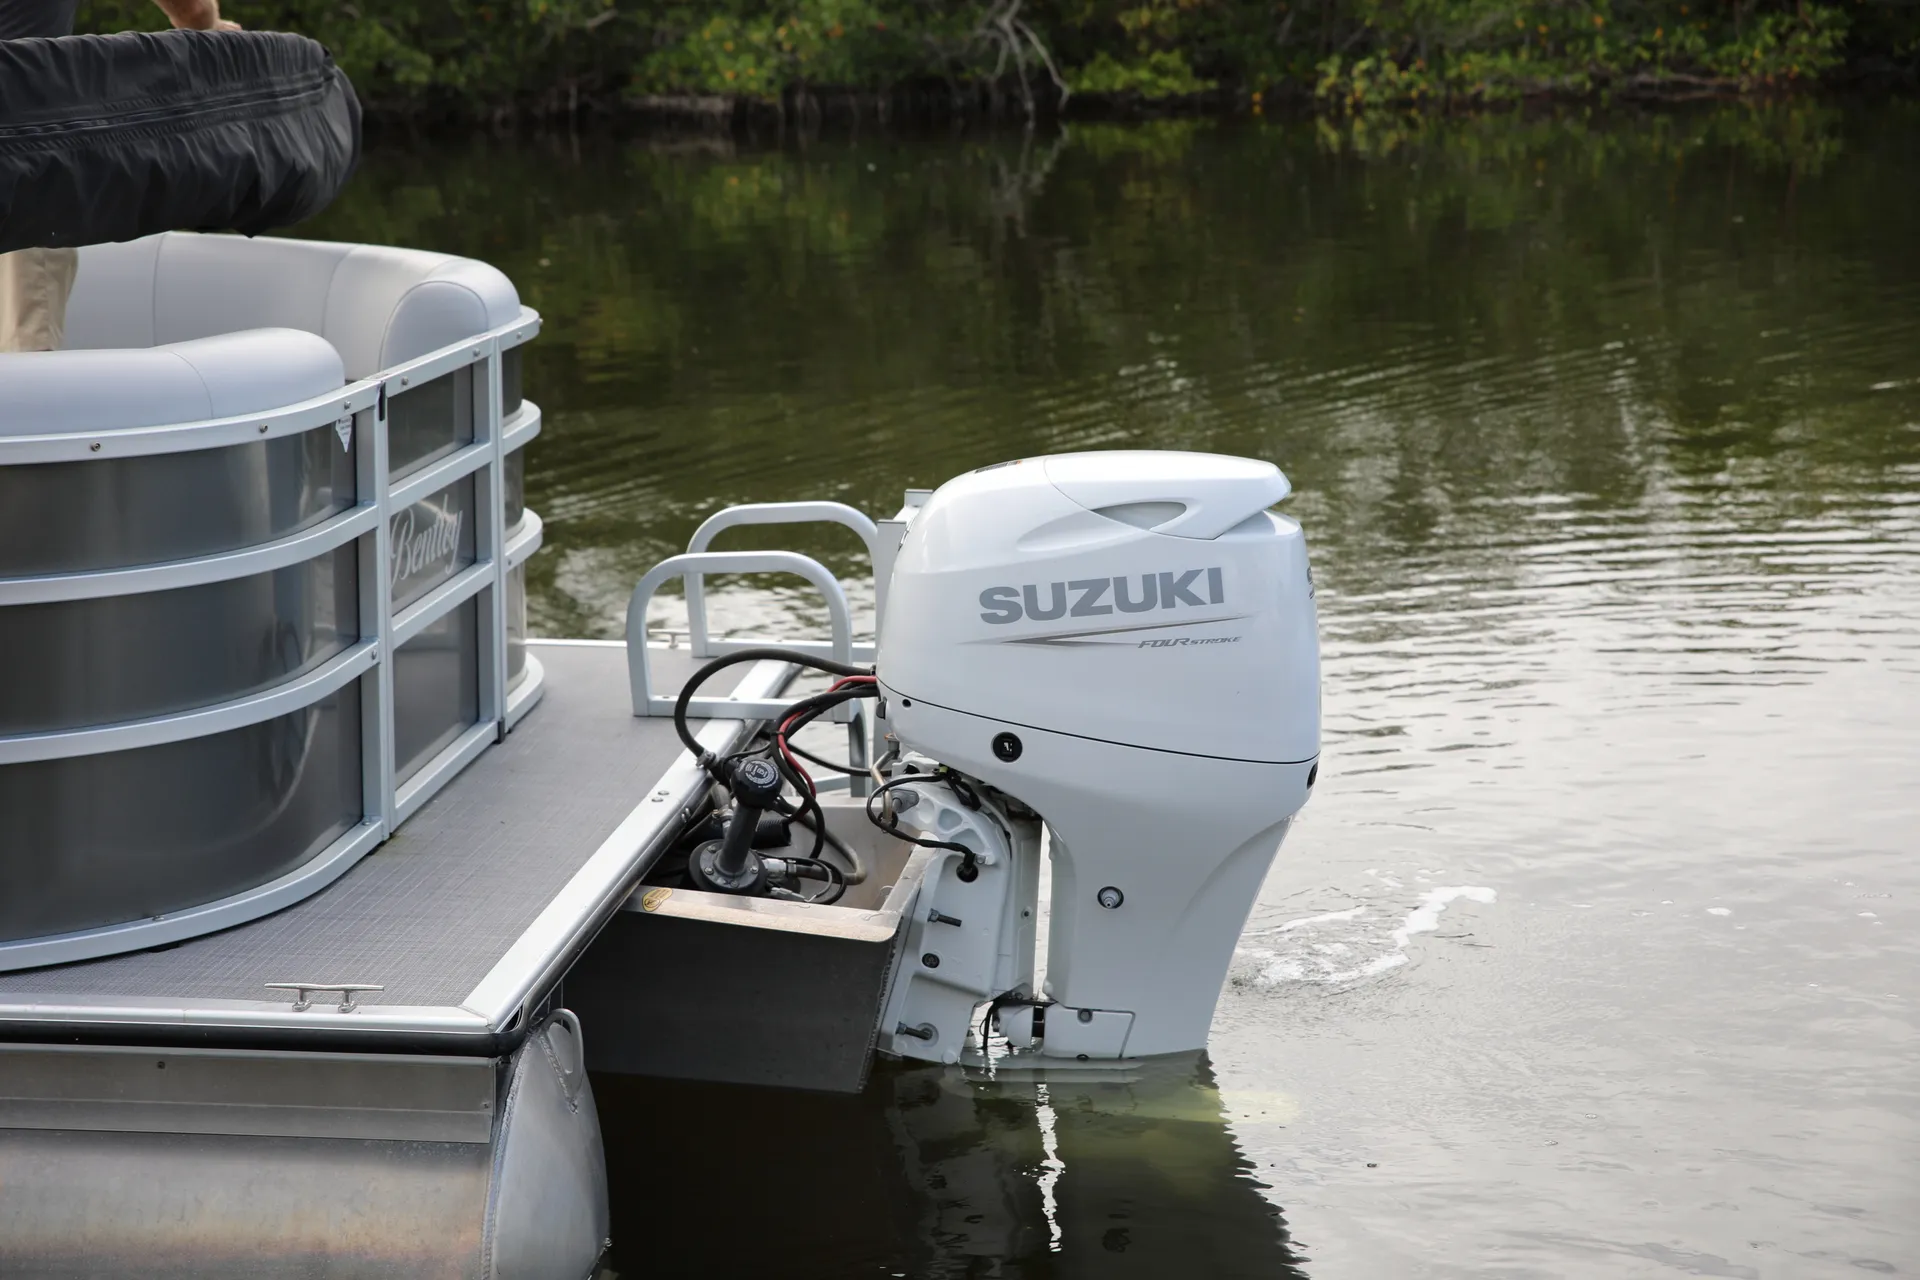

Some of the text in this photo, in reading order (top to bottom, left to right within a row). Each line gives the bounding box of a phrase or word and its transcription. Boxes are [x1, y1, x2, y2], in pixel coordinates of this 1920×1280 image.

[391, 494, 463, 587] Bentley
[979, 567, 1224, 624] SUZUKI
[1138, 636, 1242, 648] FOUR STROKE
